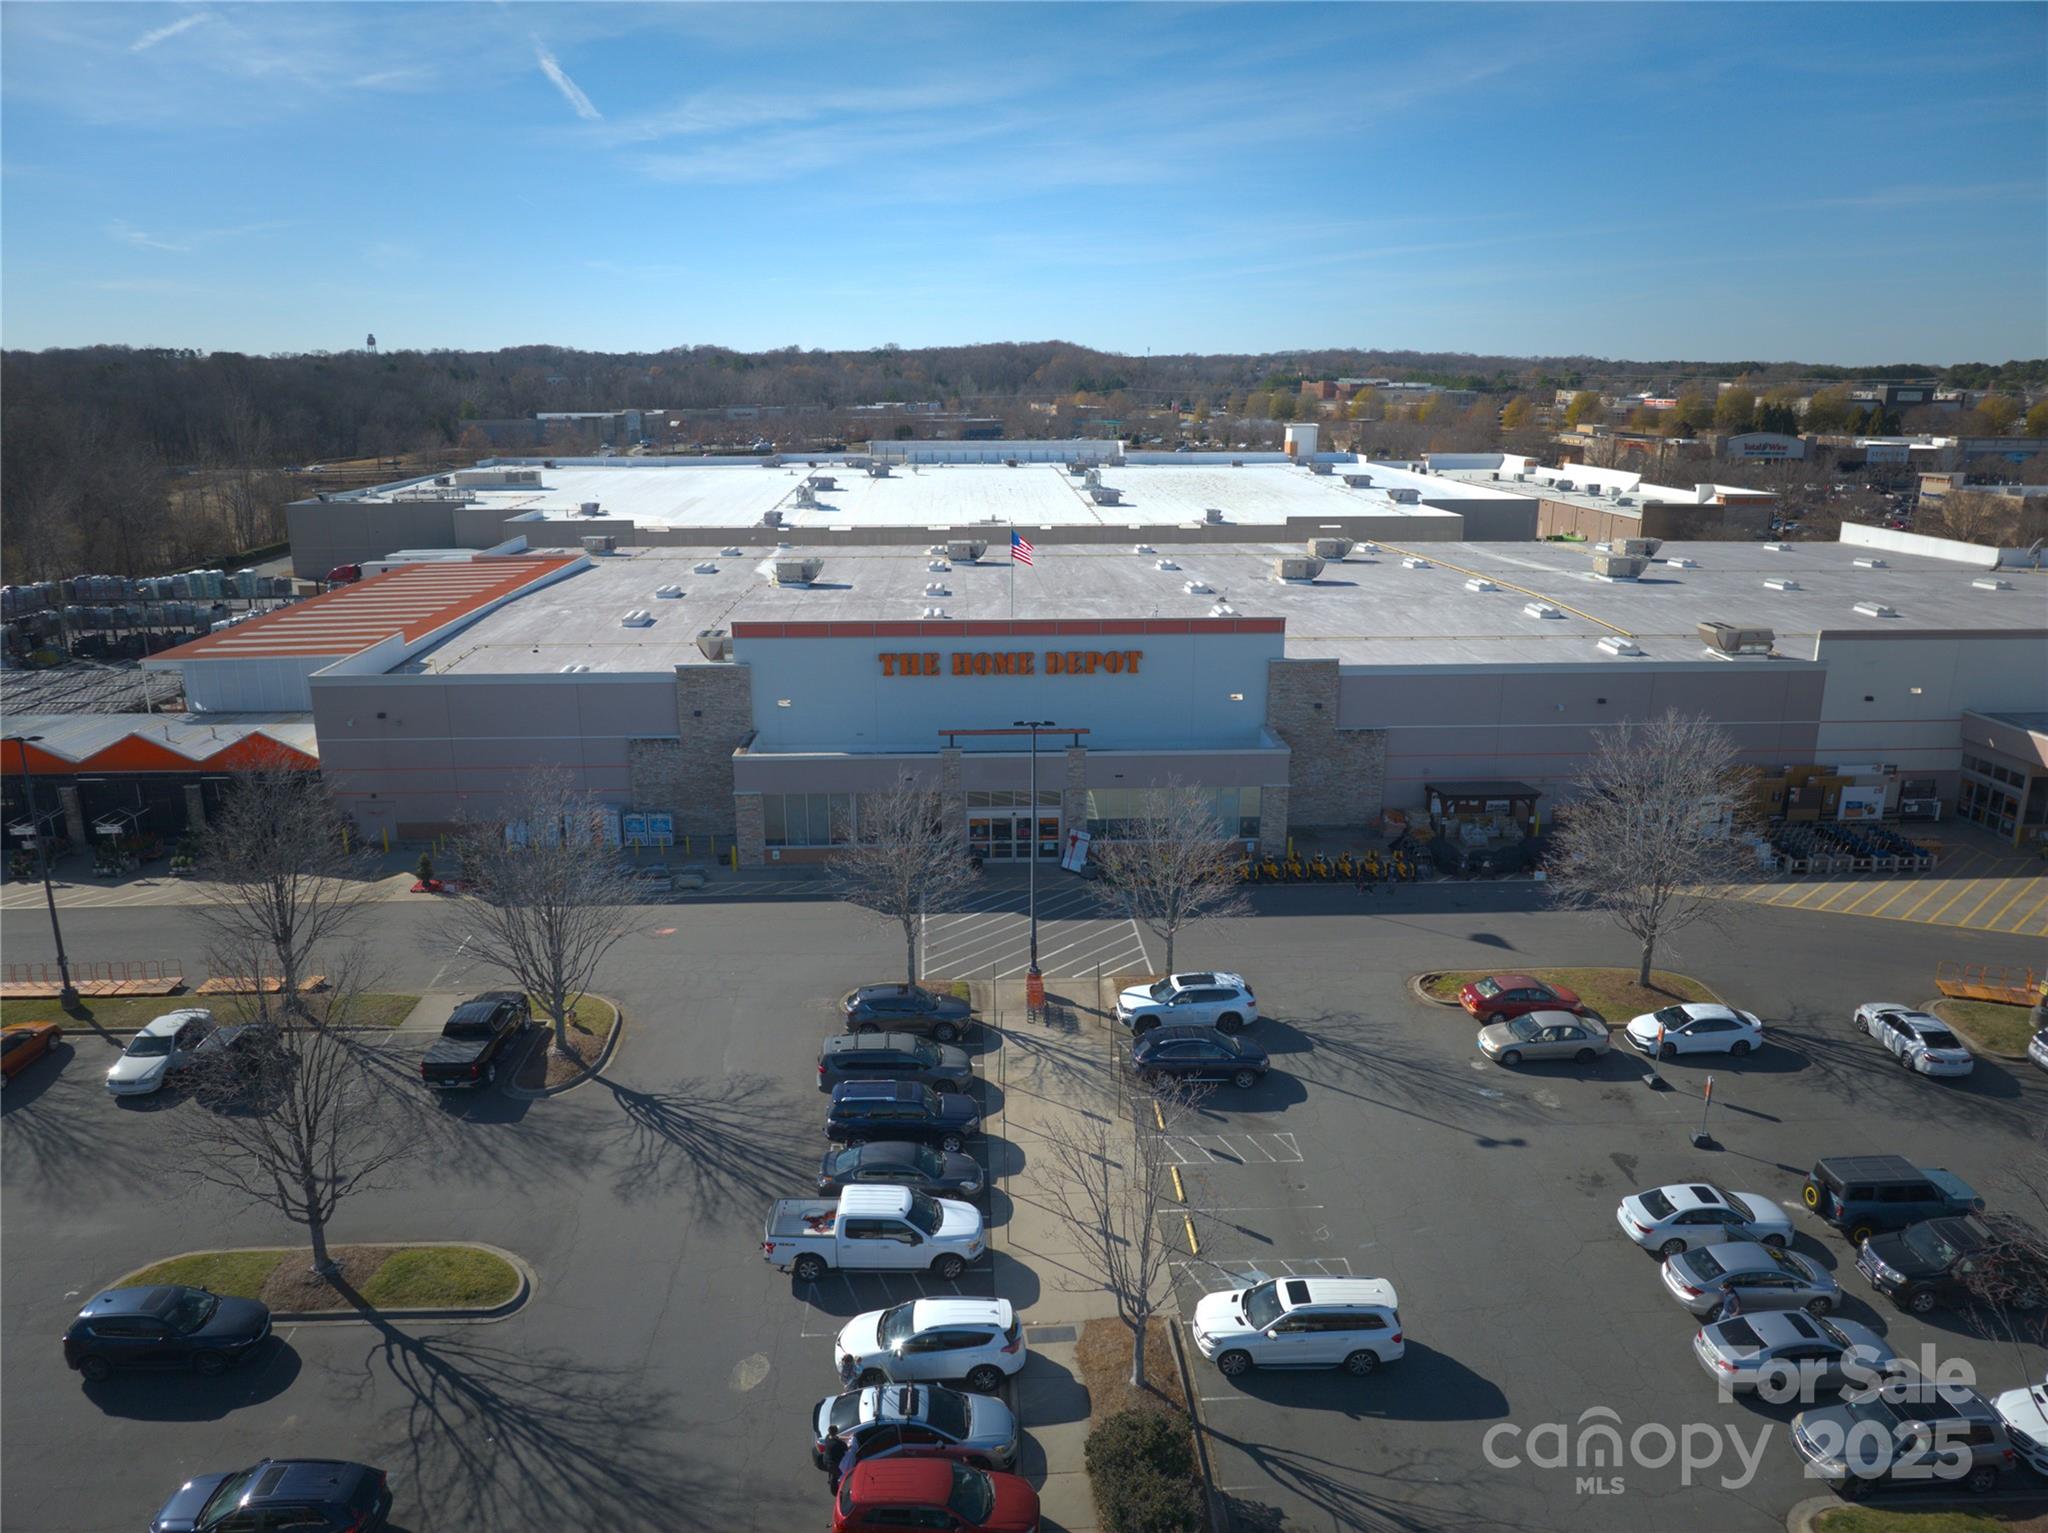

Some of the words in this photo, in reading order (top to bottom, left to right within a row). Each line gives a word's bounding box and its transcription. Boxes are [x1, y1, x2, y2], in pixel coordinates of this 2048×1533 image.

[879, 653, 940, 676] THE
[952, 652, 1035, 676] HOME
[1045, 650, 1143, 675] DEPOT
